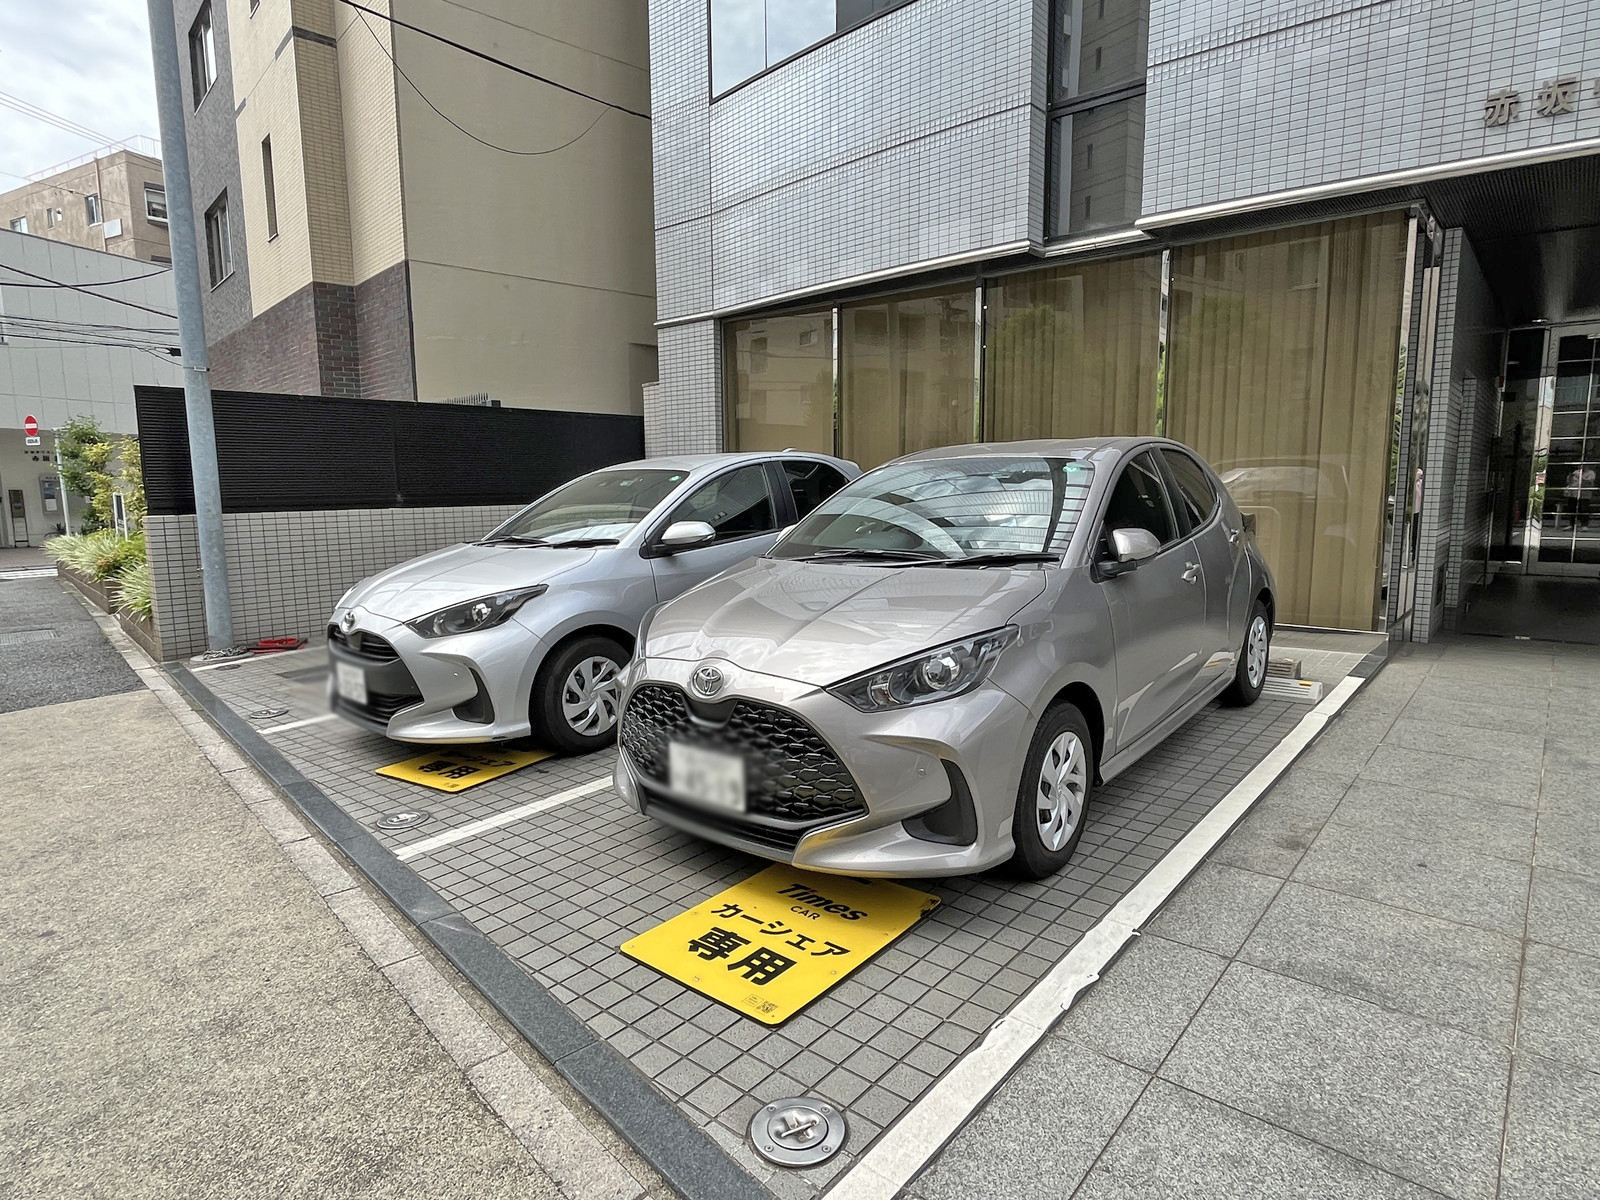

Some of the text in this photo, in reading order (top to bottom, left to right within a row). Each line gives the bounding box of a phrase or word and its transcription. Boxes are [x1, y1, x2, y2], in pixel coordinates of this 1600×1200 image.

[1484, 77, 1600, 127] 赤坂
[777, 883, 868, 920] Times
[790, 905, 820, 920] CAR
[710, 903, 851, 956] カーシェア
[687, 926, 797, 986] 専用
